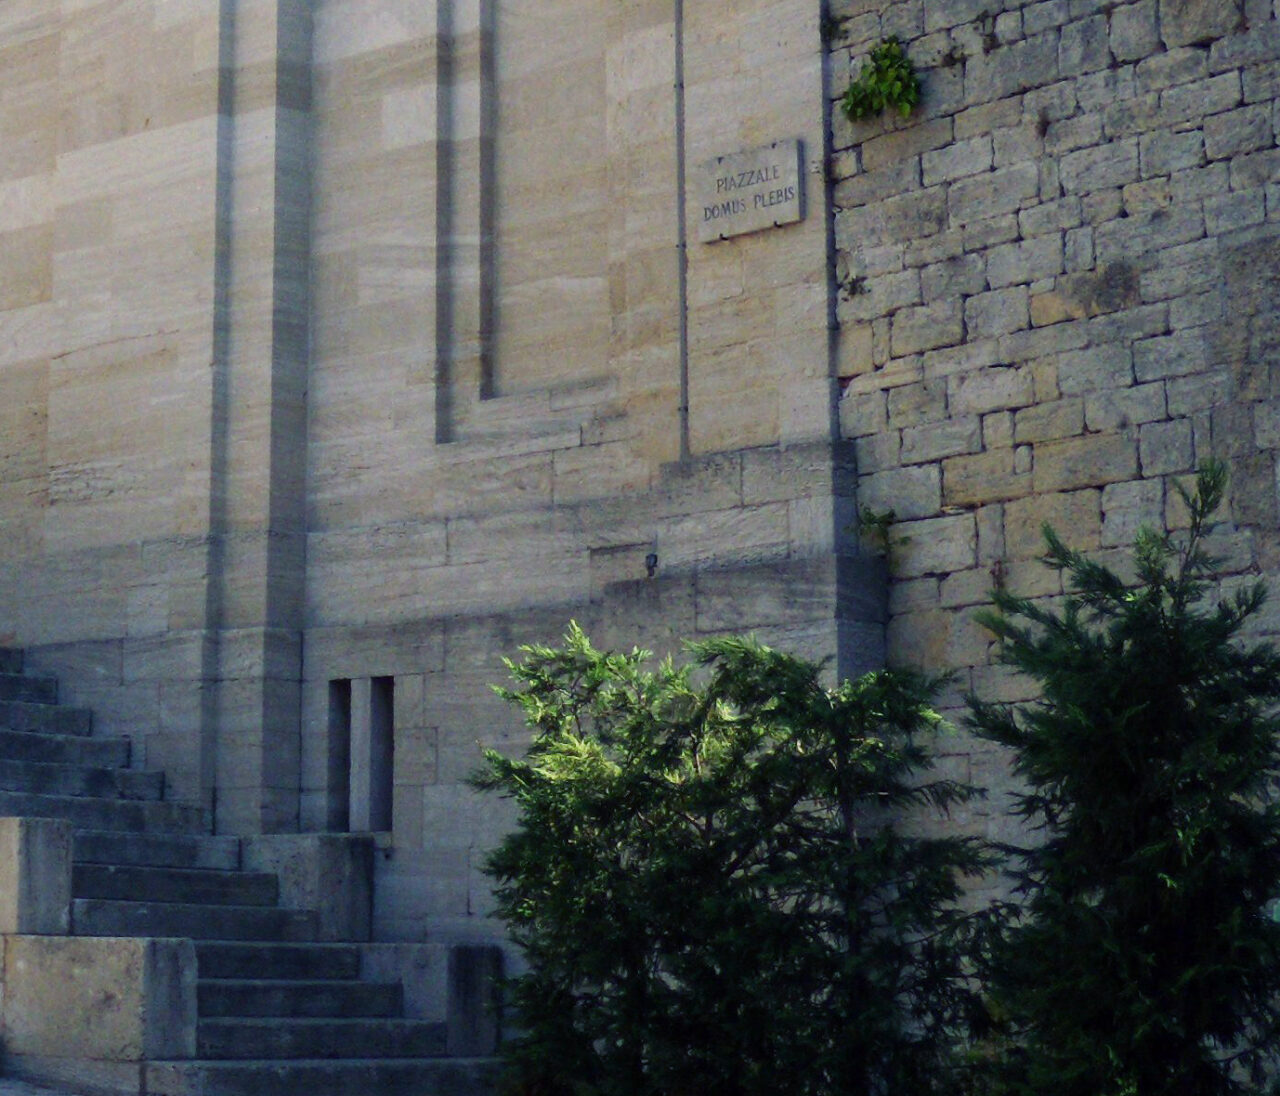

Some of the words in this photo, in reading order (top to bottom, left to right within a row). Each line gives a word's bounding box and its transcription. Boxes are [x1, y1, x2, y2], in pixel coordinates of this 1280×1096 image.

[717, 165, 780, 193] PIAZZALE
[704, 198, 746, 222] DOMUS
[754, 186, 795, 210] PLEBIS
